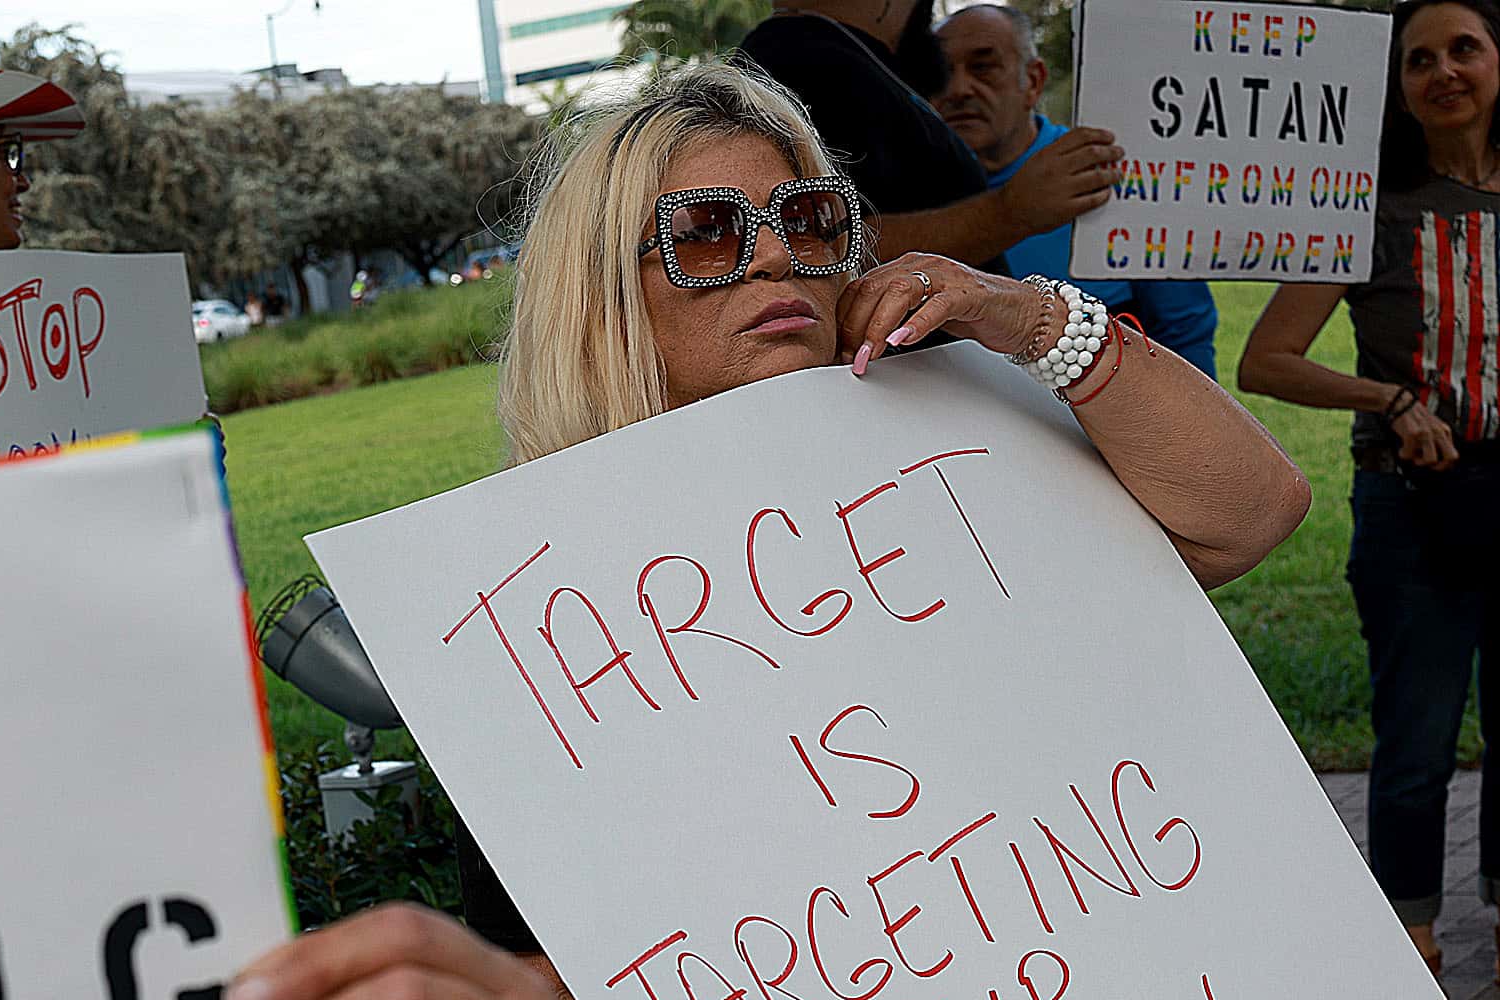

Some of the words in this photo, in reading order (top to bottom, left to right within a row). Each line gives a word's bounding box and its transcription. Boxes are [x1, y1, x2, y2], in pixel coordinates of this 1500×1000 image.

[1194, 10, 1317, 57] KEEP
[1149, 74, 1349, 146] SATAN
[1173, 160, 1295, 207] FROM
[1309, 167, 1374, 213] OUR
[1106, 226, 1354, 275] CHILDREN
[442, 447, 1012, 770] TARGET
[789, 704, 921, 819] IS
